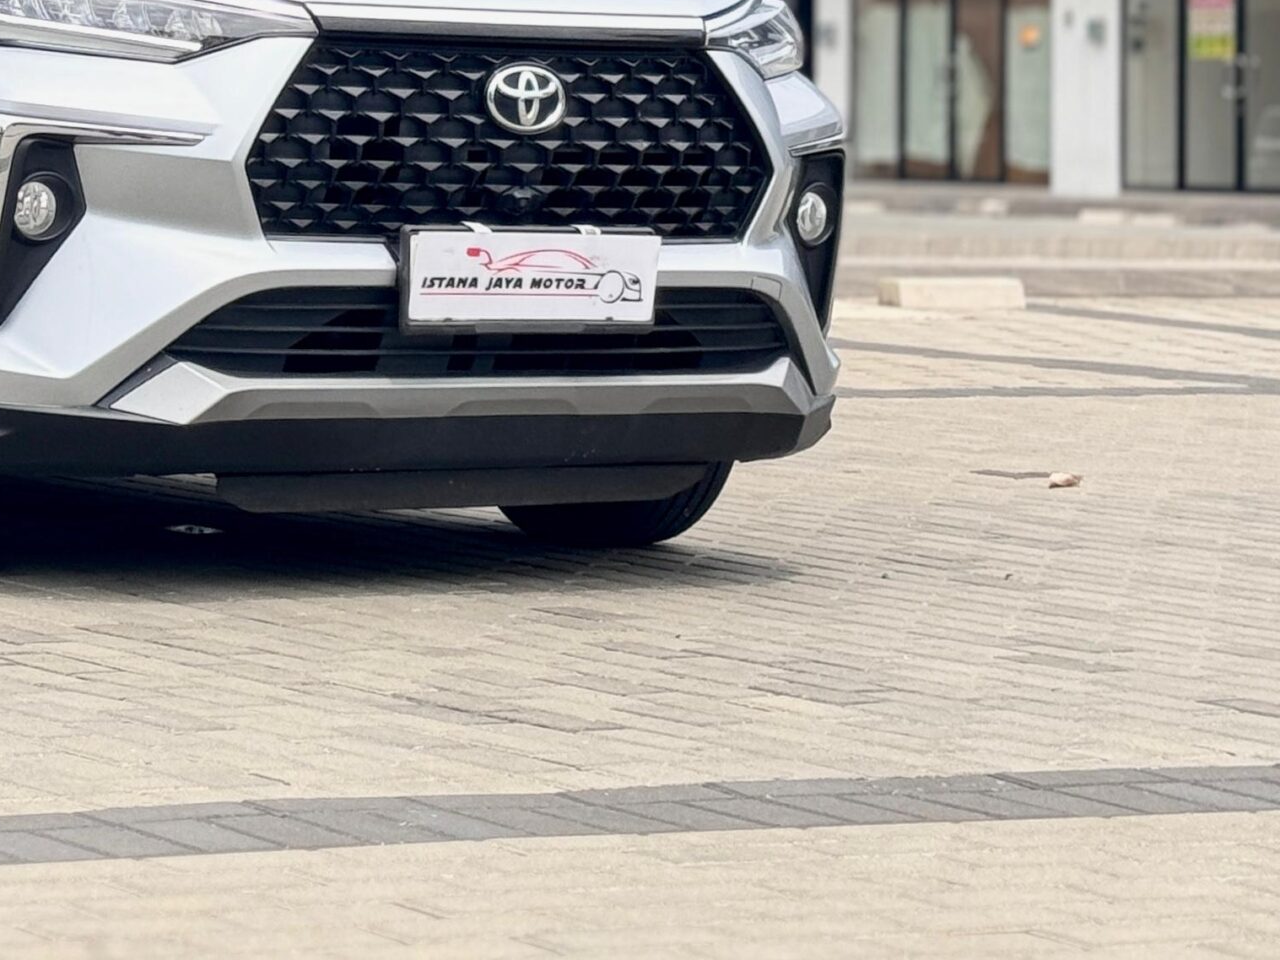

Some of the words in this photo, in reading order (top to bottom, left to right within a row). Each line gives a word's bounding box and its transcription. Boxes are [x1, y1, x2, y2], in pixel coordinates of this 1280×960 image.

[422, 276, 478, 289] ISTANA
[485, 277, 523, 291] JAYA
[529, 277, 587, 290] MOTOR
